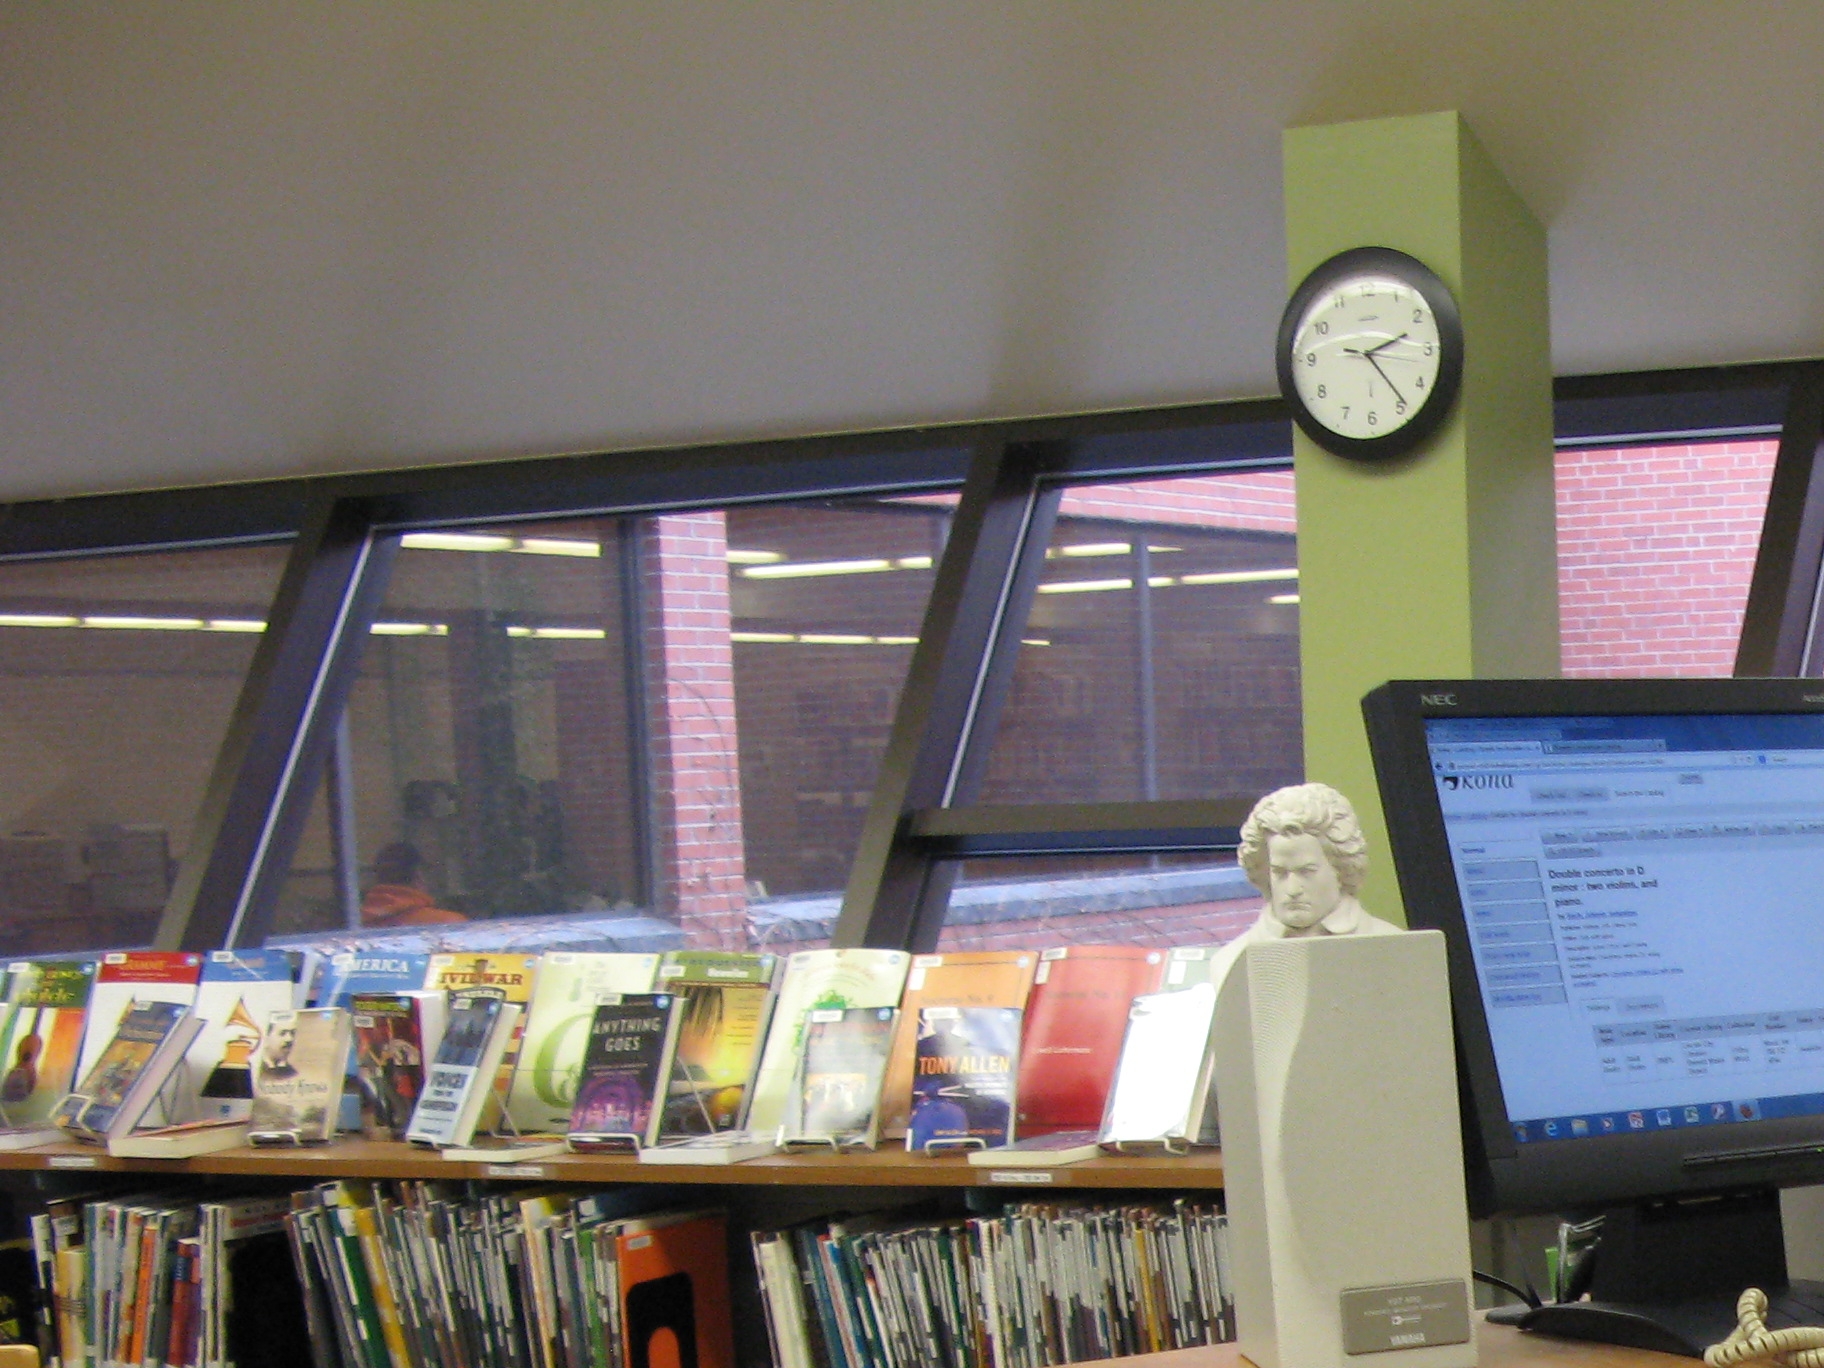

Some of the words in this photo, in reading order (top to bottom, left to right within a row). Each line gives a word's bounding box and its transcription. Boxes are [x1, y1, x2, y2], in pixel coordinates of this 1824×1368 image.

[1412, 308, 1422, 323] 2
[1314, 321, 1329, 335] 10
[1423, 341, 1433, 356] 3
[1307, 353, 1316, 367] 9
[1415, 375, 1424, 390] 4
[1317, 384, 1327, 399] 8
[1340, 406, 1351, 420] 7
[1395, 401, 1405, 416] 5
[1367, 411, 1377, 425] 6
[1421, 694, 1458, 706] NEC
[1548, 869, 1582, 879] Double
[1584, 868, 1625, 878] concerto
[1637, 866, 1644, 875] D
[1551, 883, 1579, 892] minor
[1586, 882, 1603, 891] two
[1640, 879, 1658, 888] and
[593, 1016, 663, 1034] ANYTHING
[605, 1036, 641, 1052] GOES
[920, 1056, 957, 1075] TONY
[958, 1055, 1011, 1074] ALLEN
